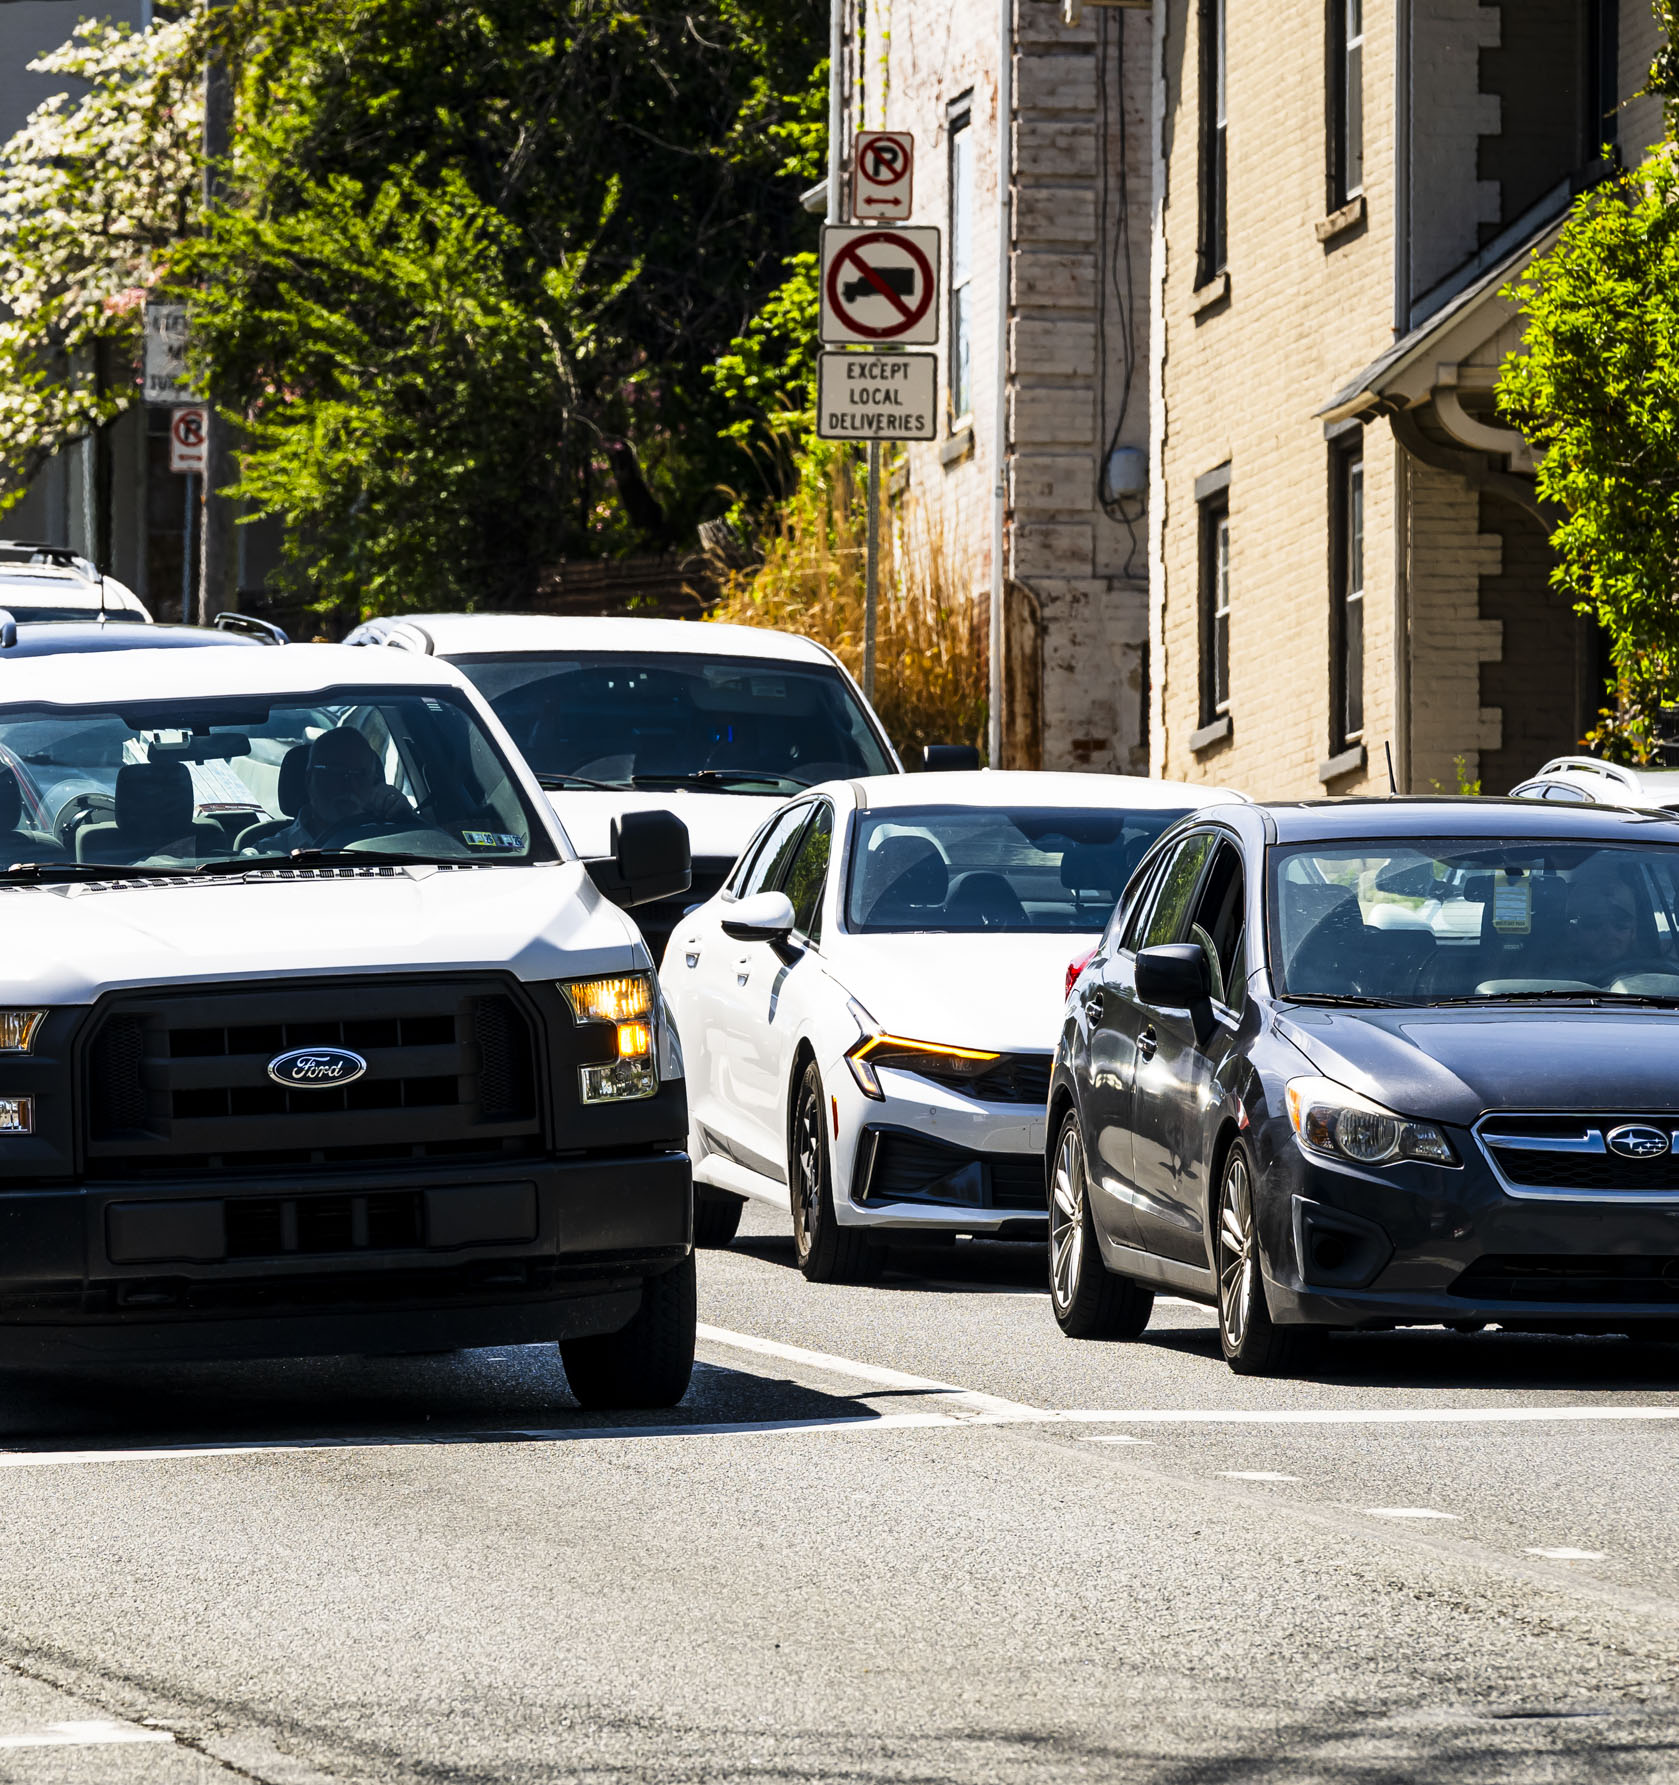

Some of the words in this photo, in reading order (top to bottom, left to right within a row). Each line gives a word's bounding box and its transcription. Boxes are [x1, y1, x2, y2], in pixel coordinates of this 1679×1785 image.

[847, 362, 911, 380] EXCEPT
[849, 388, 903, 405] LOCAL
[829, 413, 925, 431] DELIVERIES
[292, 1056, 344, 1079] Ford
